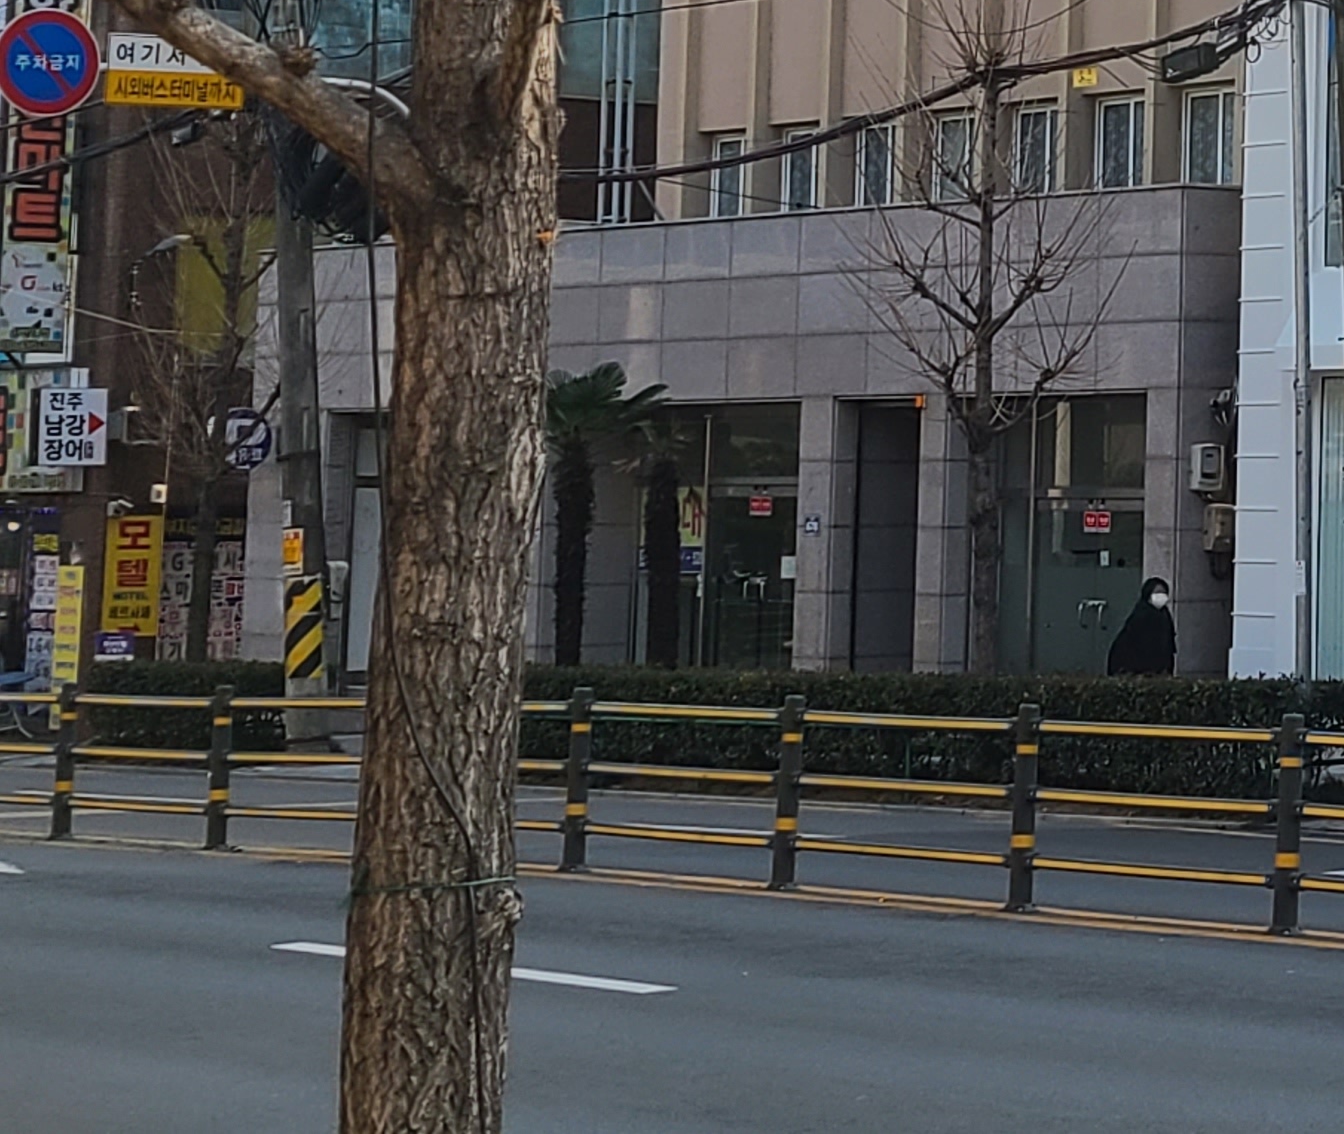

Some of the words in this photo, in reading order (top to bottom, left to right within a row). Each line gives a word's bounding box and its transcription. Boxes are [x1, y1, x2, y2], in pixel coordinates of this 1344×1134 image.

[15, 53, 80, 72] 주차금지
[113, 79, 238, 105] 시외버스터미널까지
[49, 392, 83, 412] 진주
[45, 415, 85, 438] 남강
[44, 439, 86, 463] 장어
[116, 520, 151, 588] 모텔
